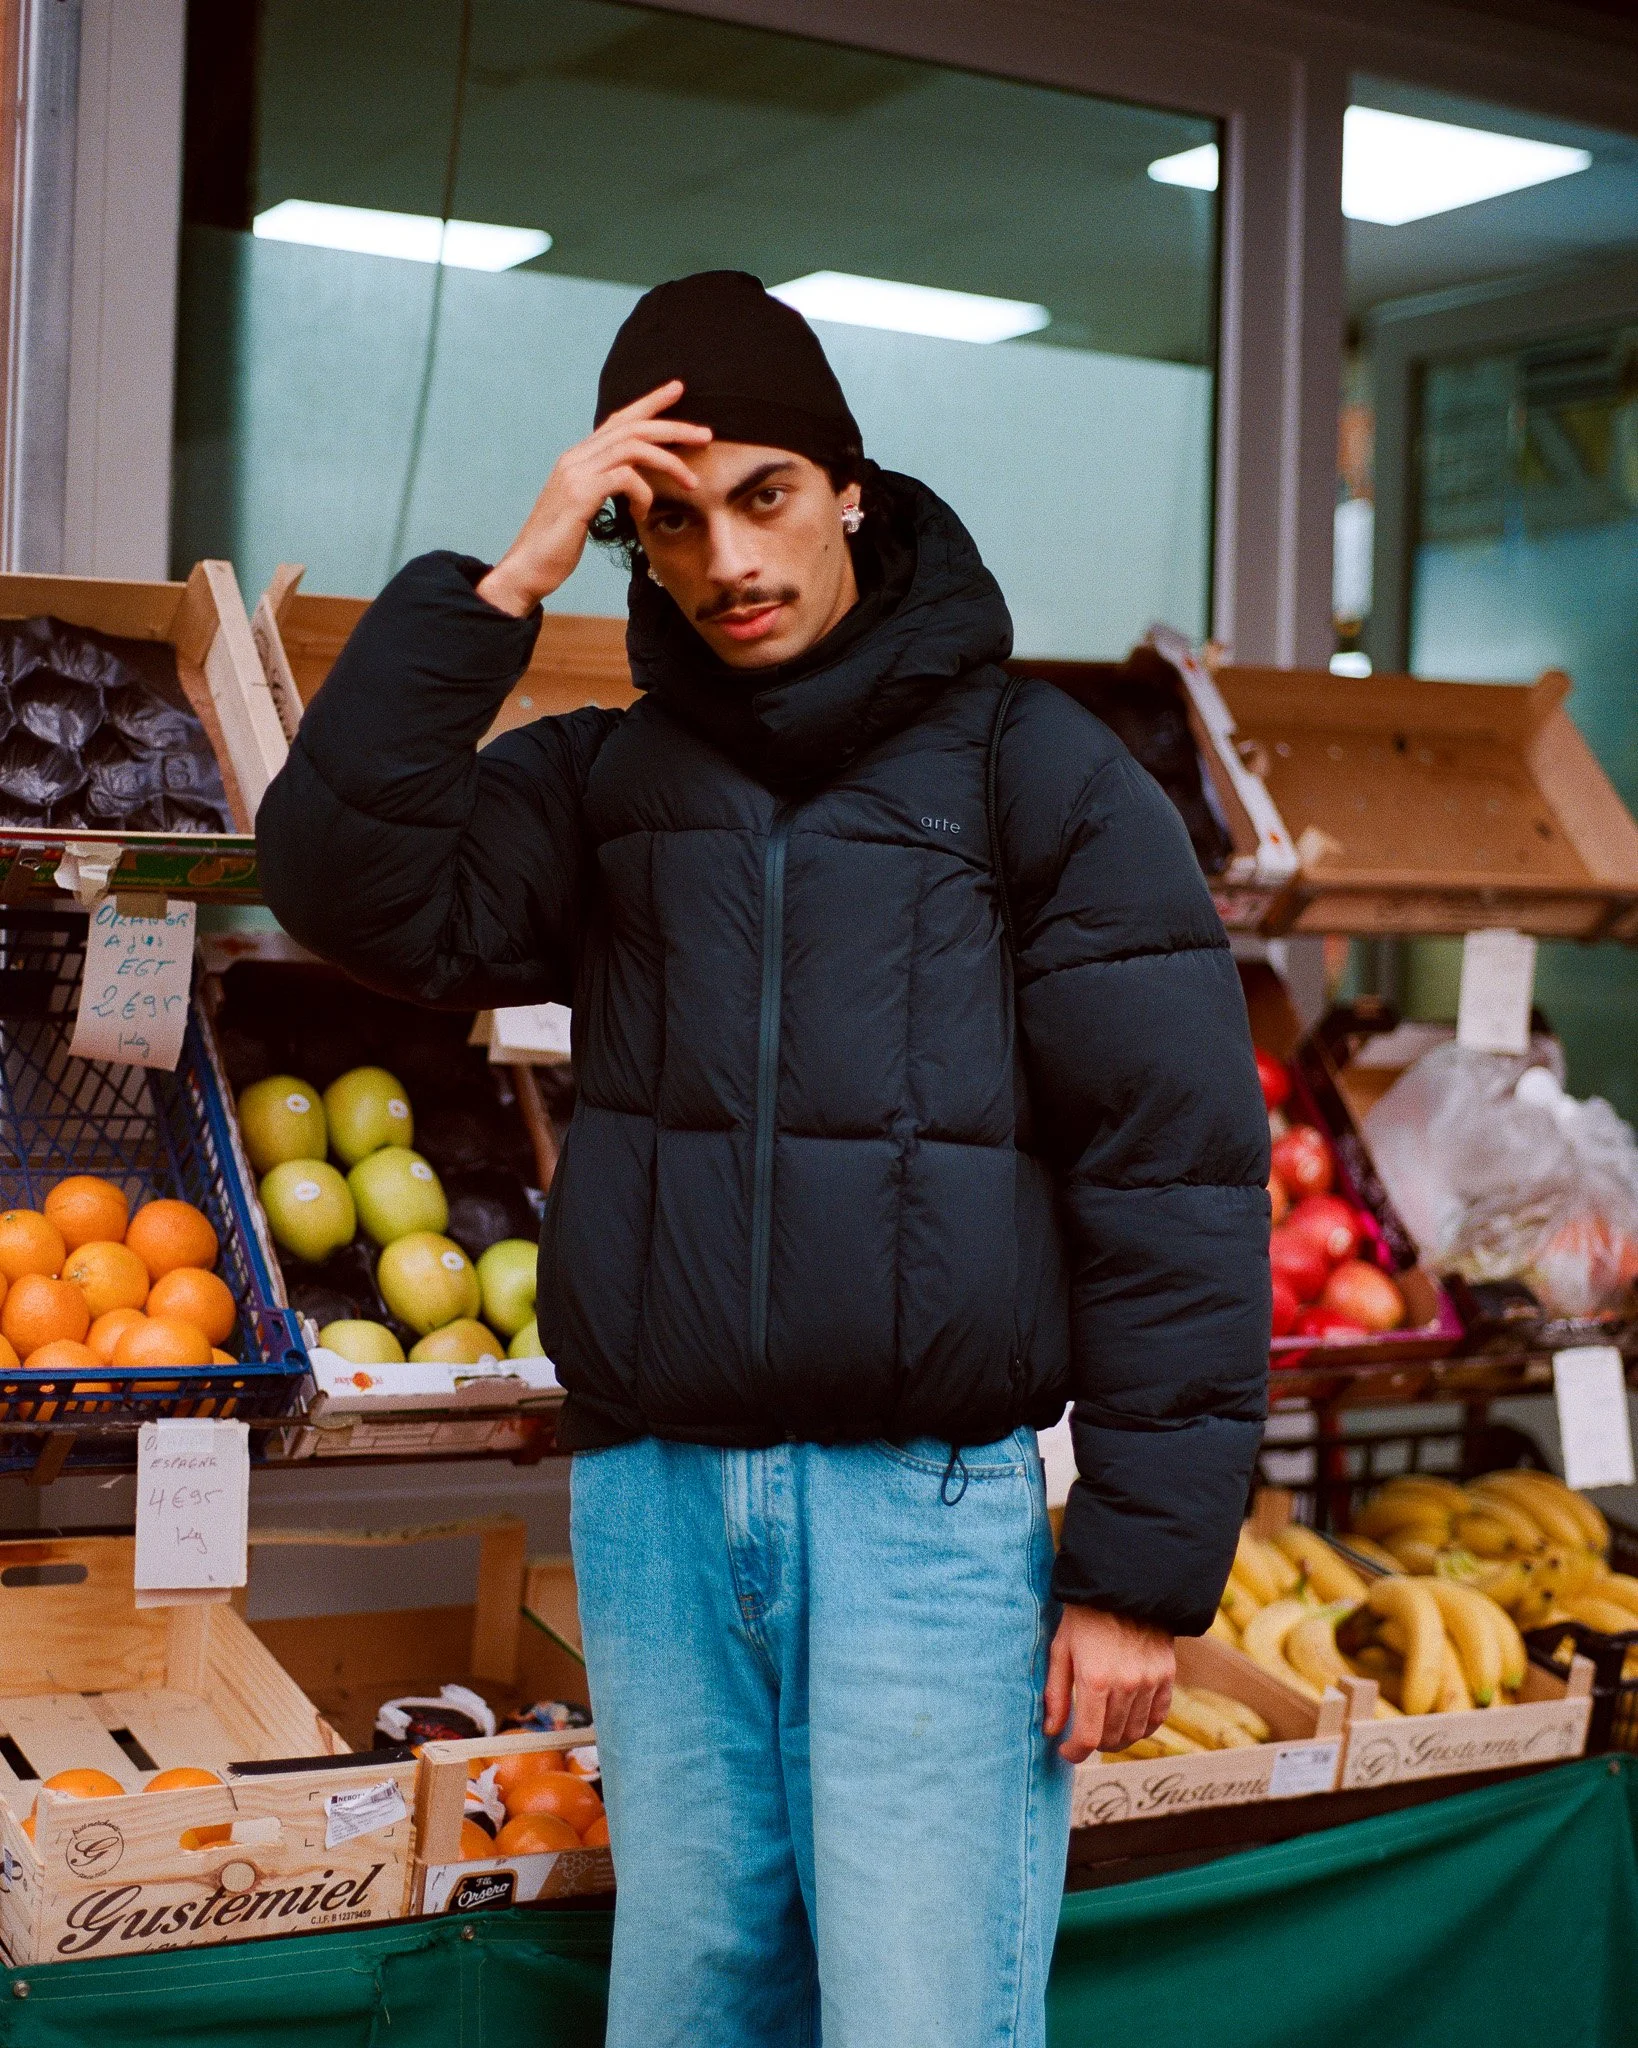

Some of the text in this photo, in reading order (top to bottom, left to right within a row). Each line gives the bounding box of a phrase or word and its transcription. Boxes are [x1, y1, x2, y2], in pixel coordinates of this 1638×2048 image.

[920, 816, 961, 834] arte
[57, 1862, 386, 1954] Gustemiel
[457, 1882, 511, 1909] Orsero
